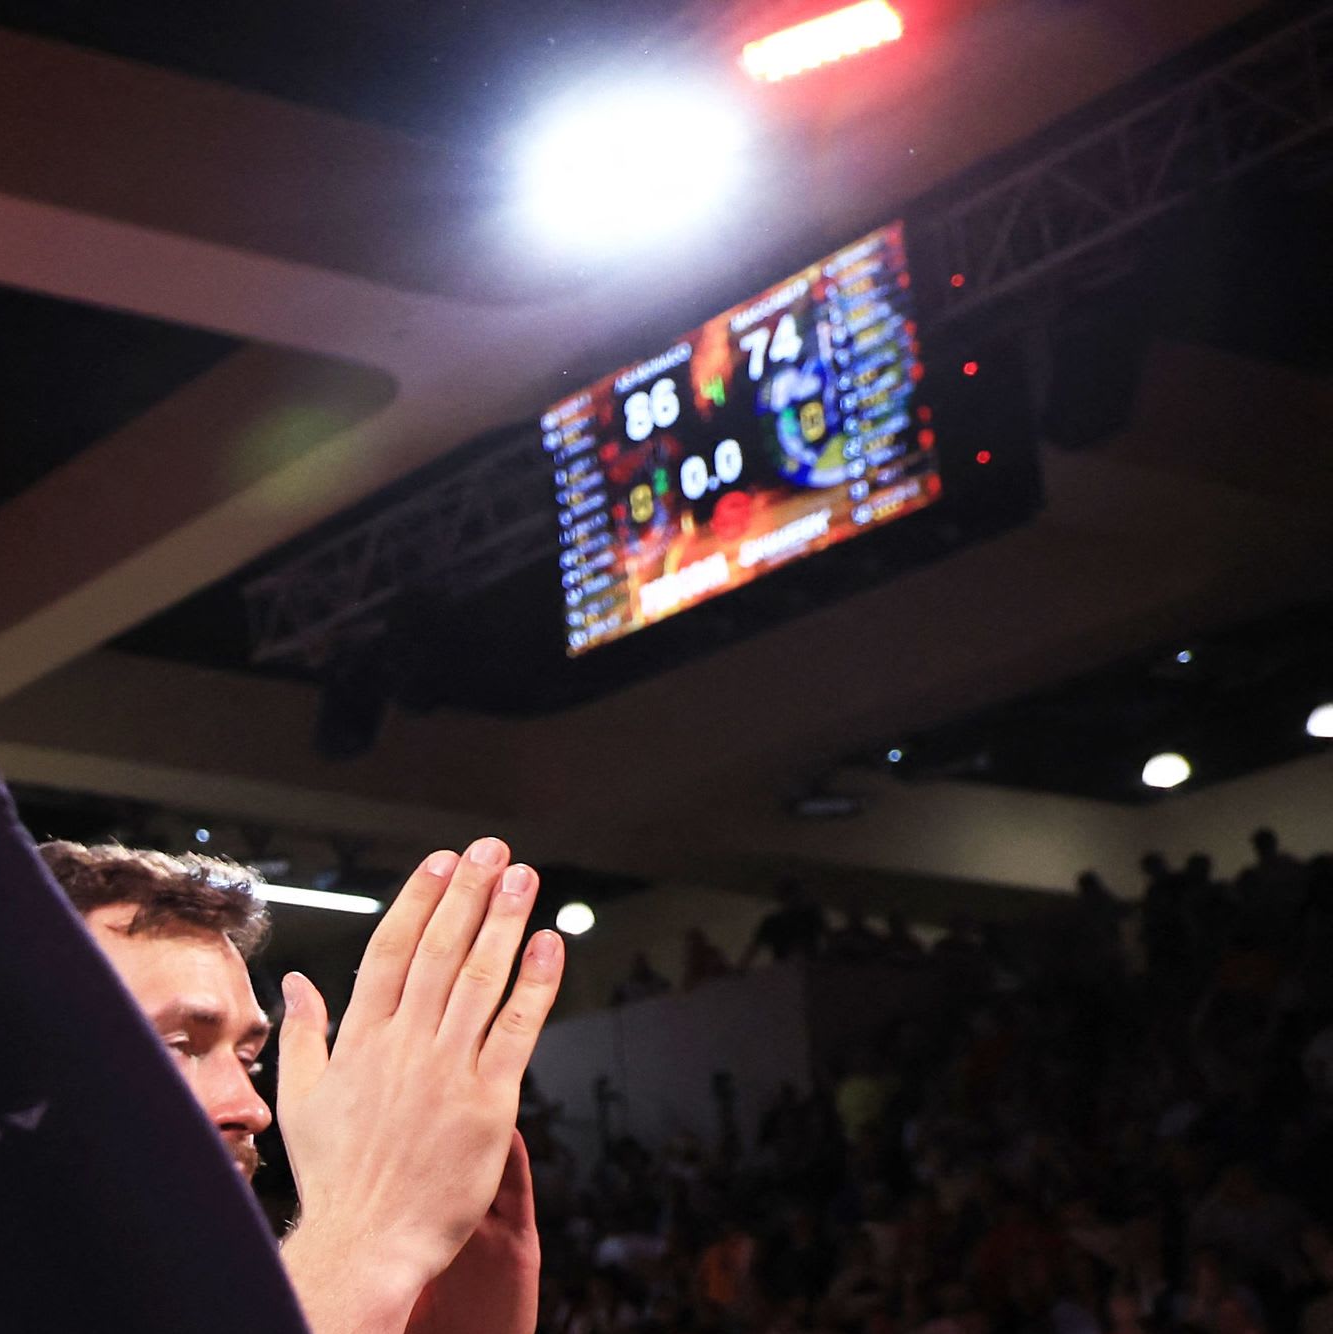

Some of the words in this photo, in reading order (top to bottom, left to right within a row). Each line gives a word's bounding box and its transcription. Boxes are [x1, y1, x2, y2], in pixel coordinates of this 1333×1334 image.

[740, 313, 803, 381] 74
[625, 377, 680, 441] 86
[680, 438, 743, 500] 0.0
